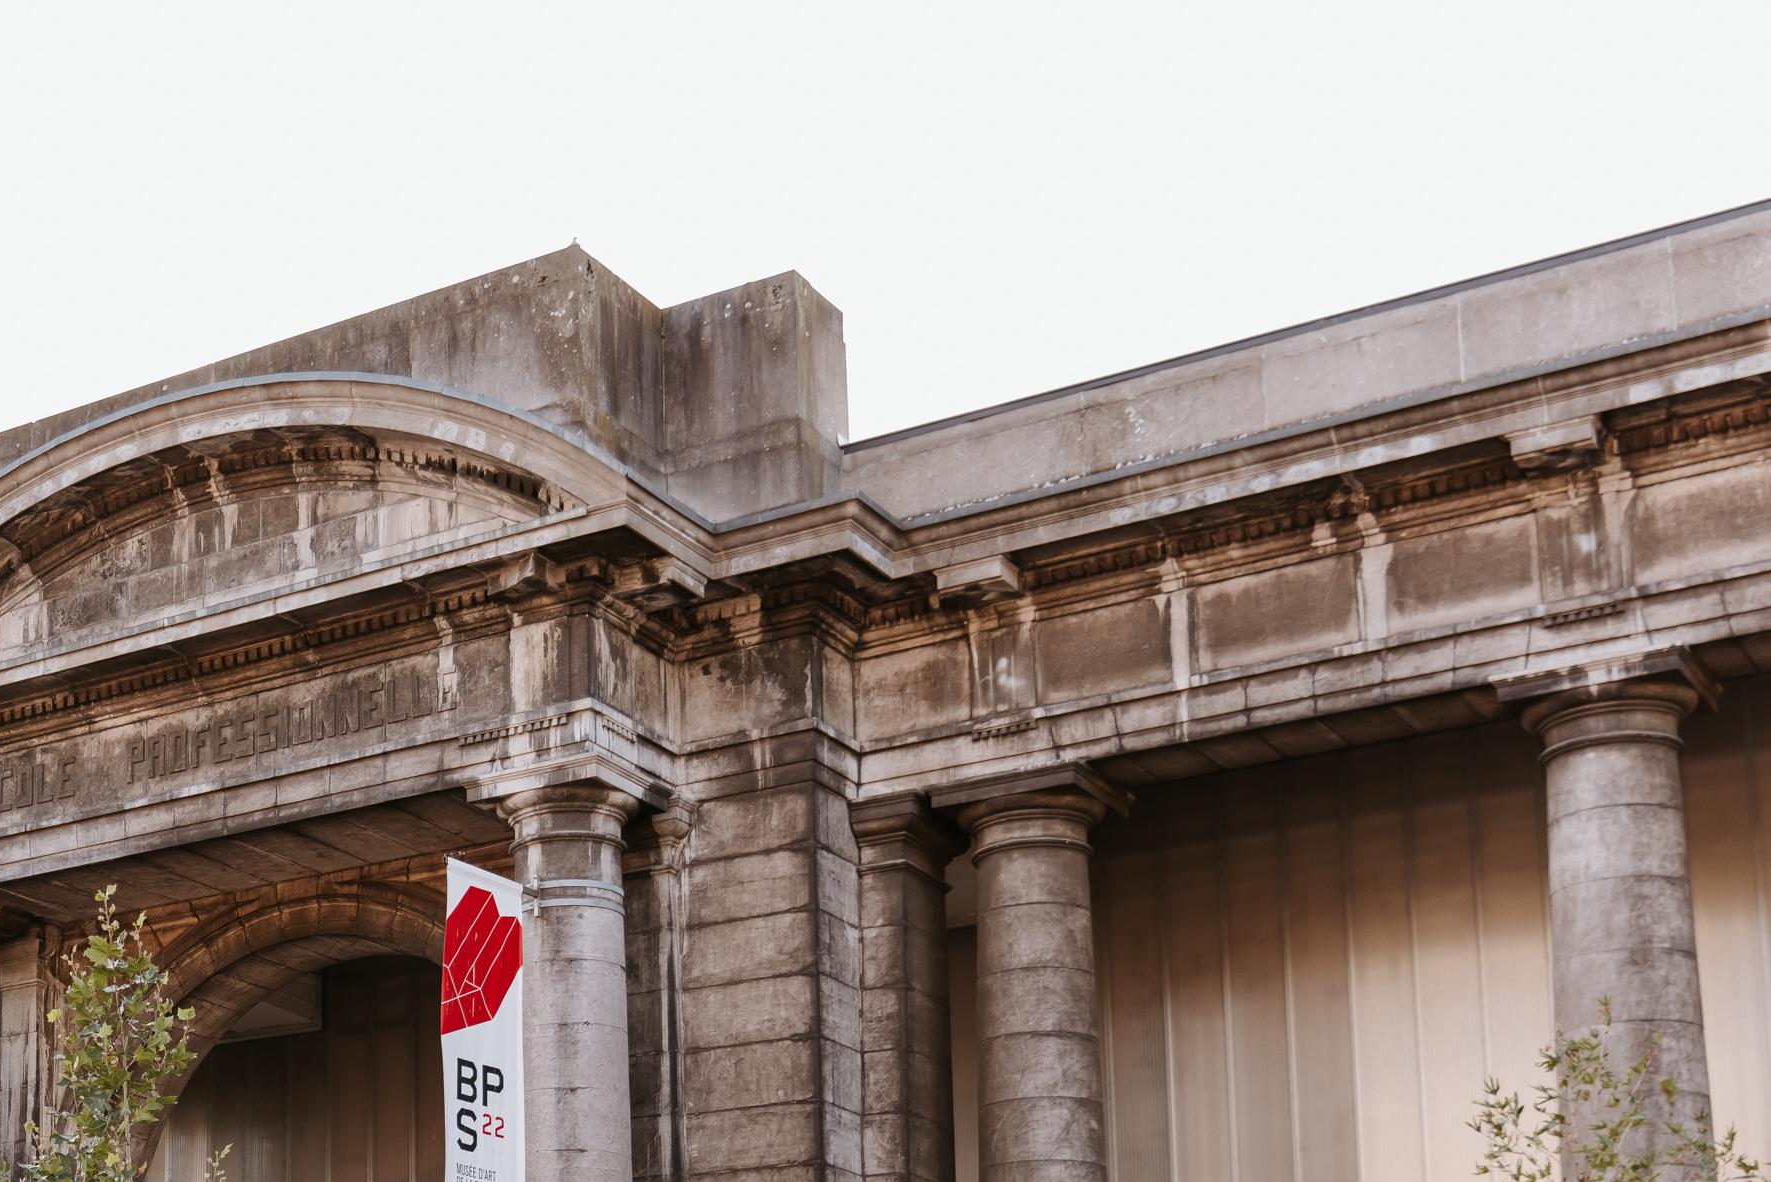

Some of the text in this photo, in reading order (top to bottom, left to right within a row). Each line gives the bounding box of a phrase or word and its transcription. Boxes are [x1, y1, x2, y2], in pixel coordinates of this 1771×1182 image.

[127, 668, 457, 784] PROFESSIONNELLE
[457, 1058, 504, 1107] BP
[457, 1163, 496, 1182] MUSÉE D'ART
